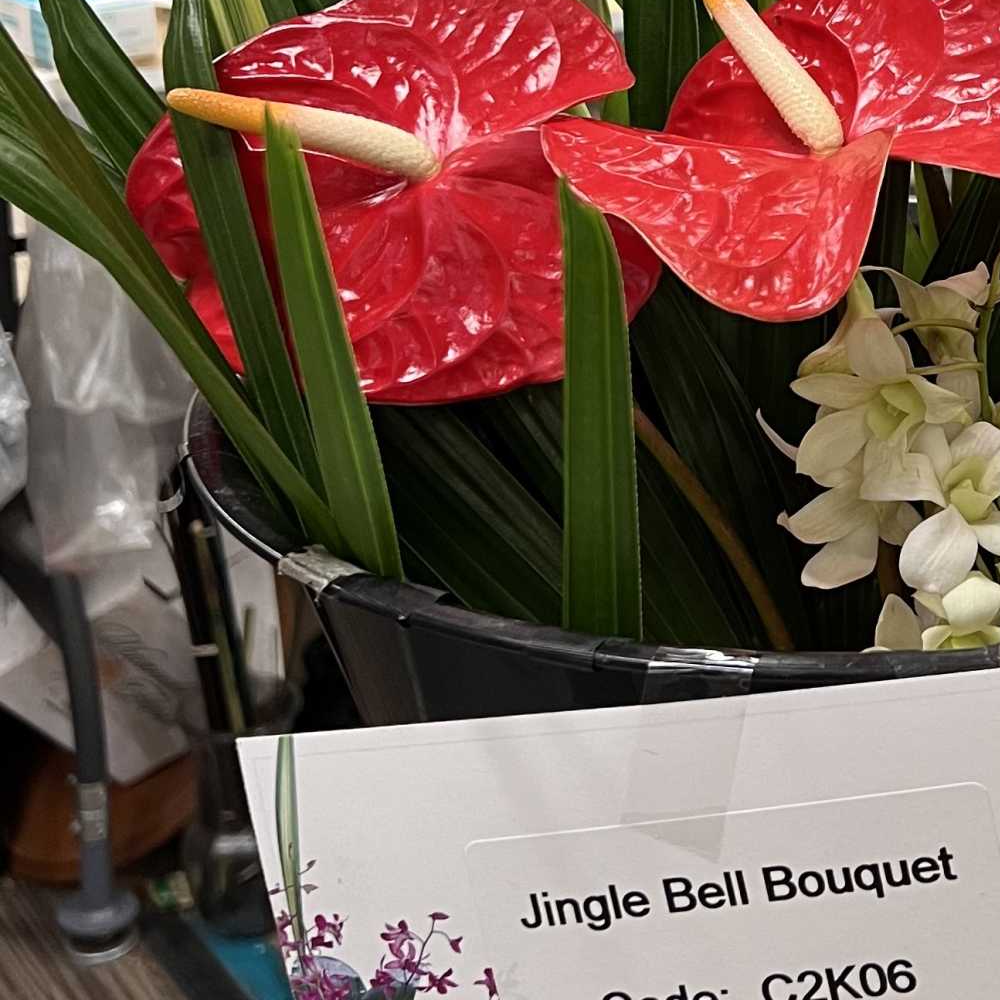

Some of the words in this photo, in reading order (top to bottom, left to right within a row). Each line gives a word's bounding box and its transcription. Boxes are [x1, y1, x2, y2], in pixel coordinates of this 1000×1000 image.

[520, 884, 651, 931] Jingle
[662, 870, 749, 914] Bell
[761, 846, 958, 902] Bouquet
[761, 959, 917, 1000] C2K06
